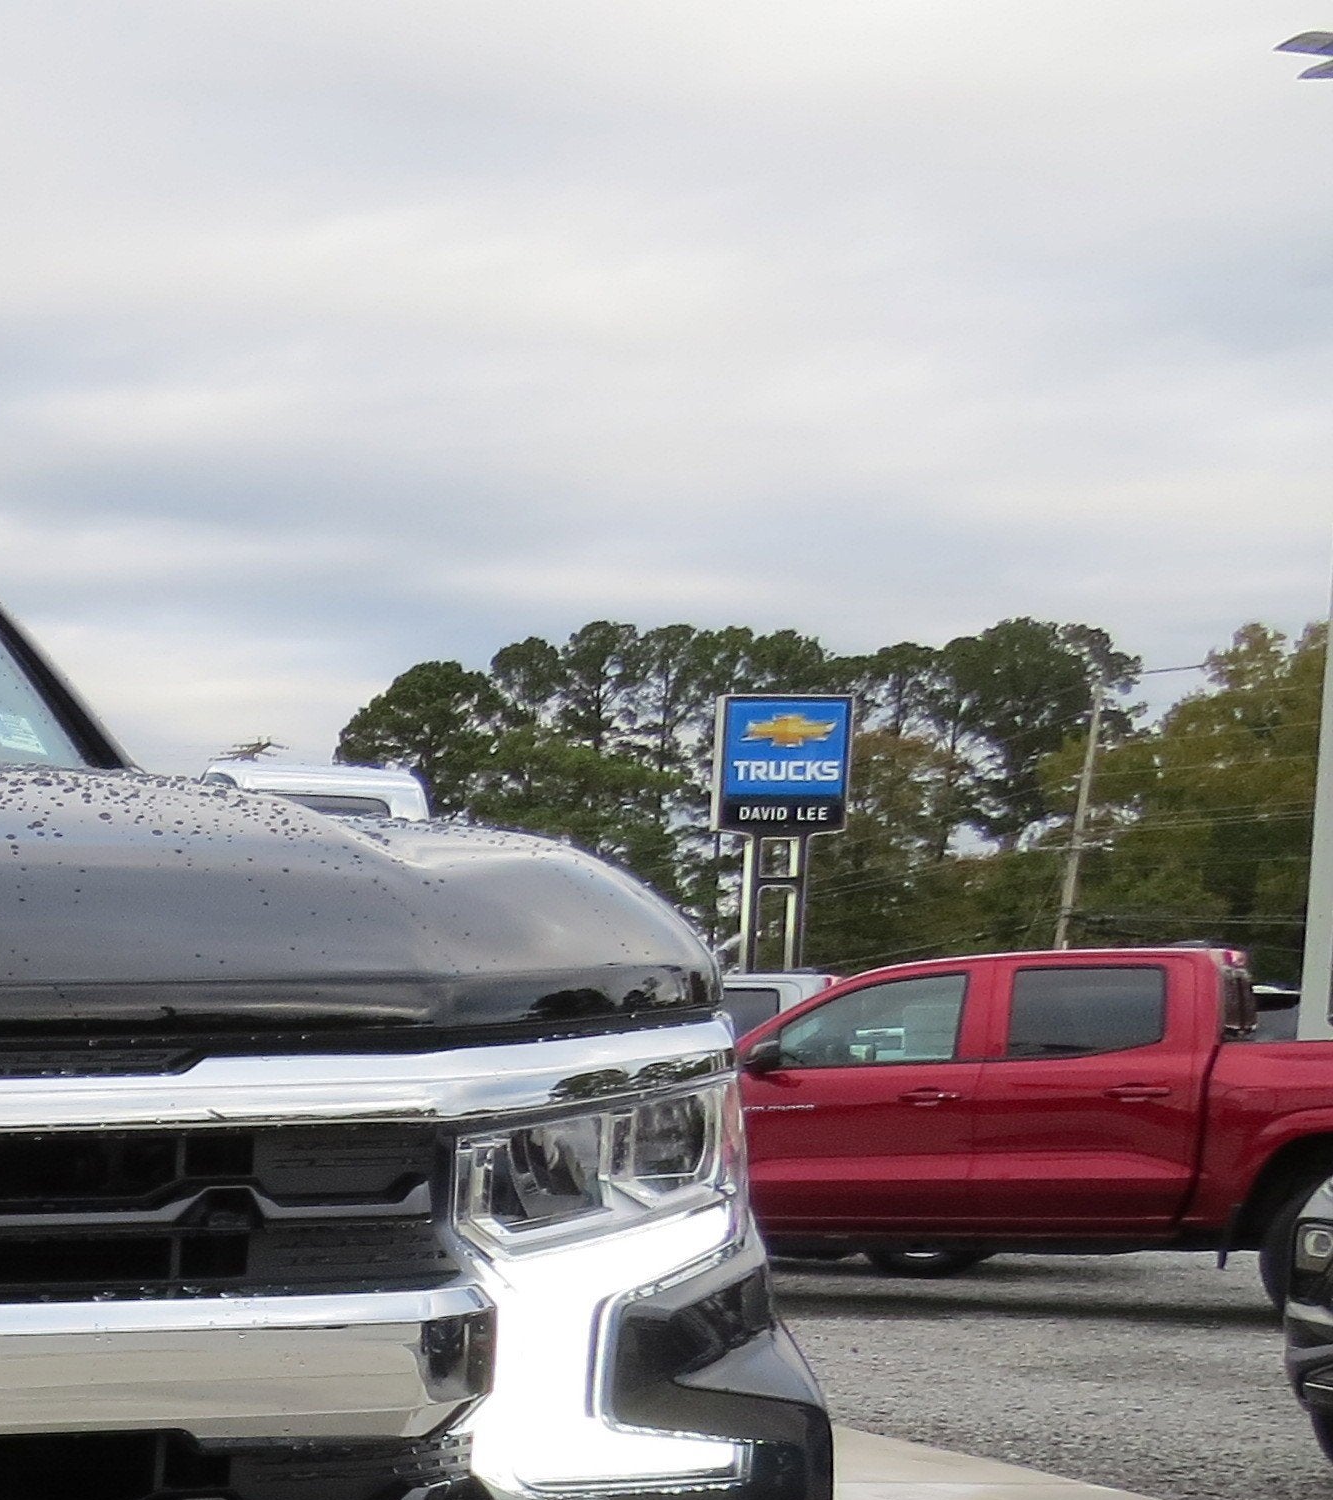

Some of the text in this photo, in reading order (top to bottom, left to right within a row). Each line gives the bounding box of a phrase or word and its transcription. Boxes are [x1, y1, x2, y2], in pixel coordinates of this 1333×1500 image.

[734, 760, 840, 782] TRUCKS
[739, 806, 828, 821] DAVID LEE
